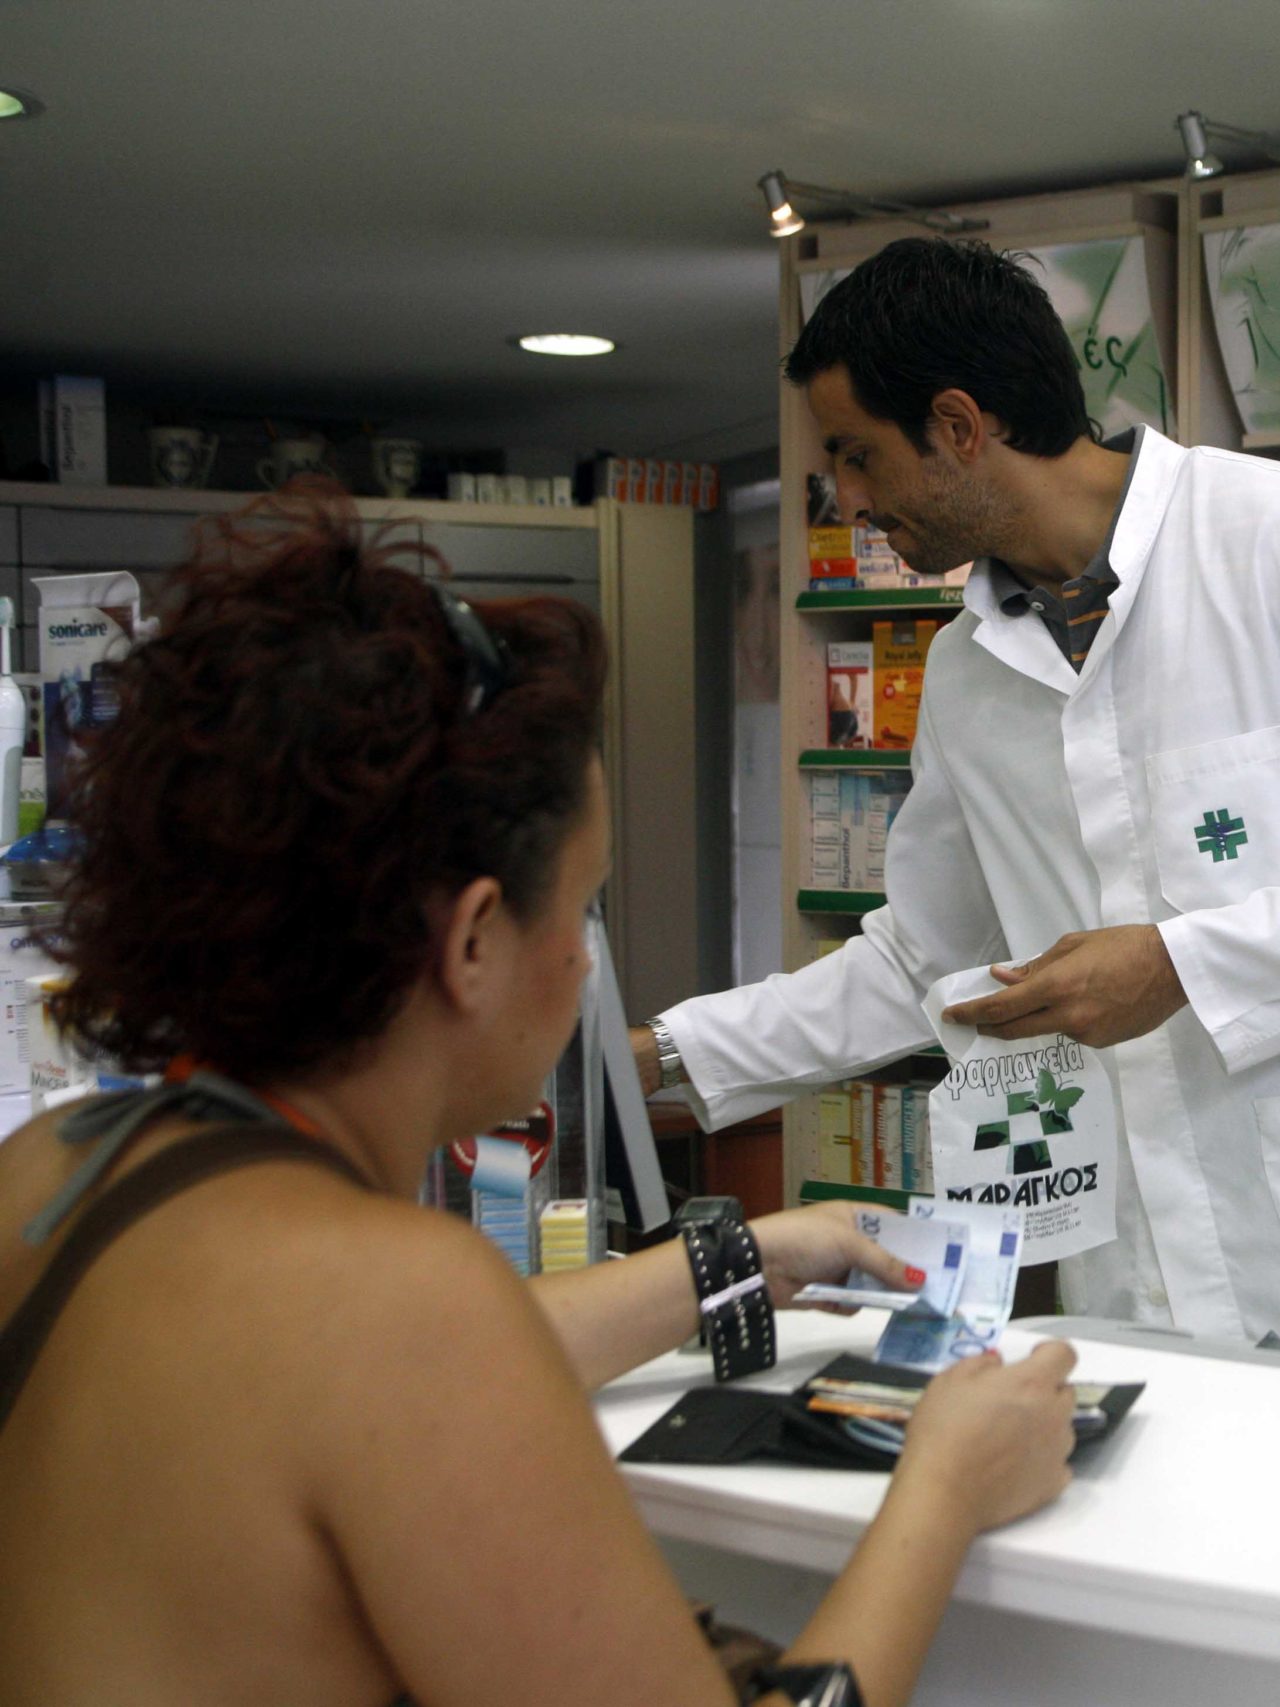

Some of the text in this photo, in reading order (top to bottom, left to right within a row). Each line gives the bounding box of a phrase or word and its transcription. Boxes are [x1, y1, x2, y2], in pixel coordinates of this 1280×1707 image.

[49, 618, 108, 639] sonicare
[944, 1034, 1085, 1101] φαρμακεία
[947, 1162, 1099, 1209] ΜΑΡΑΓΚΟΣ
